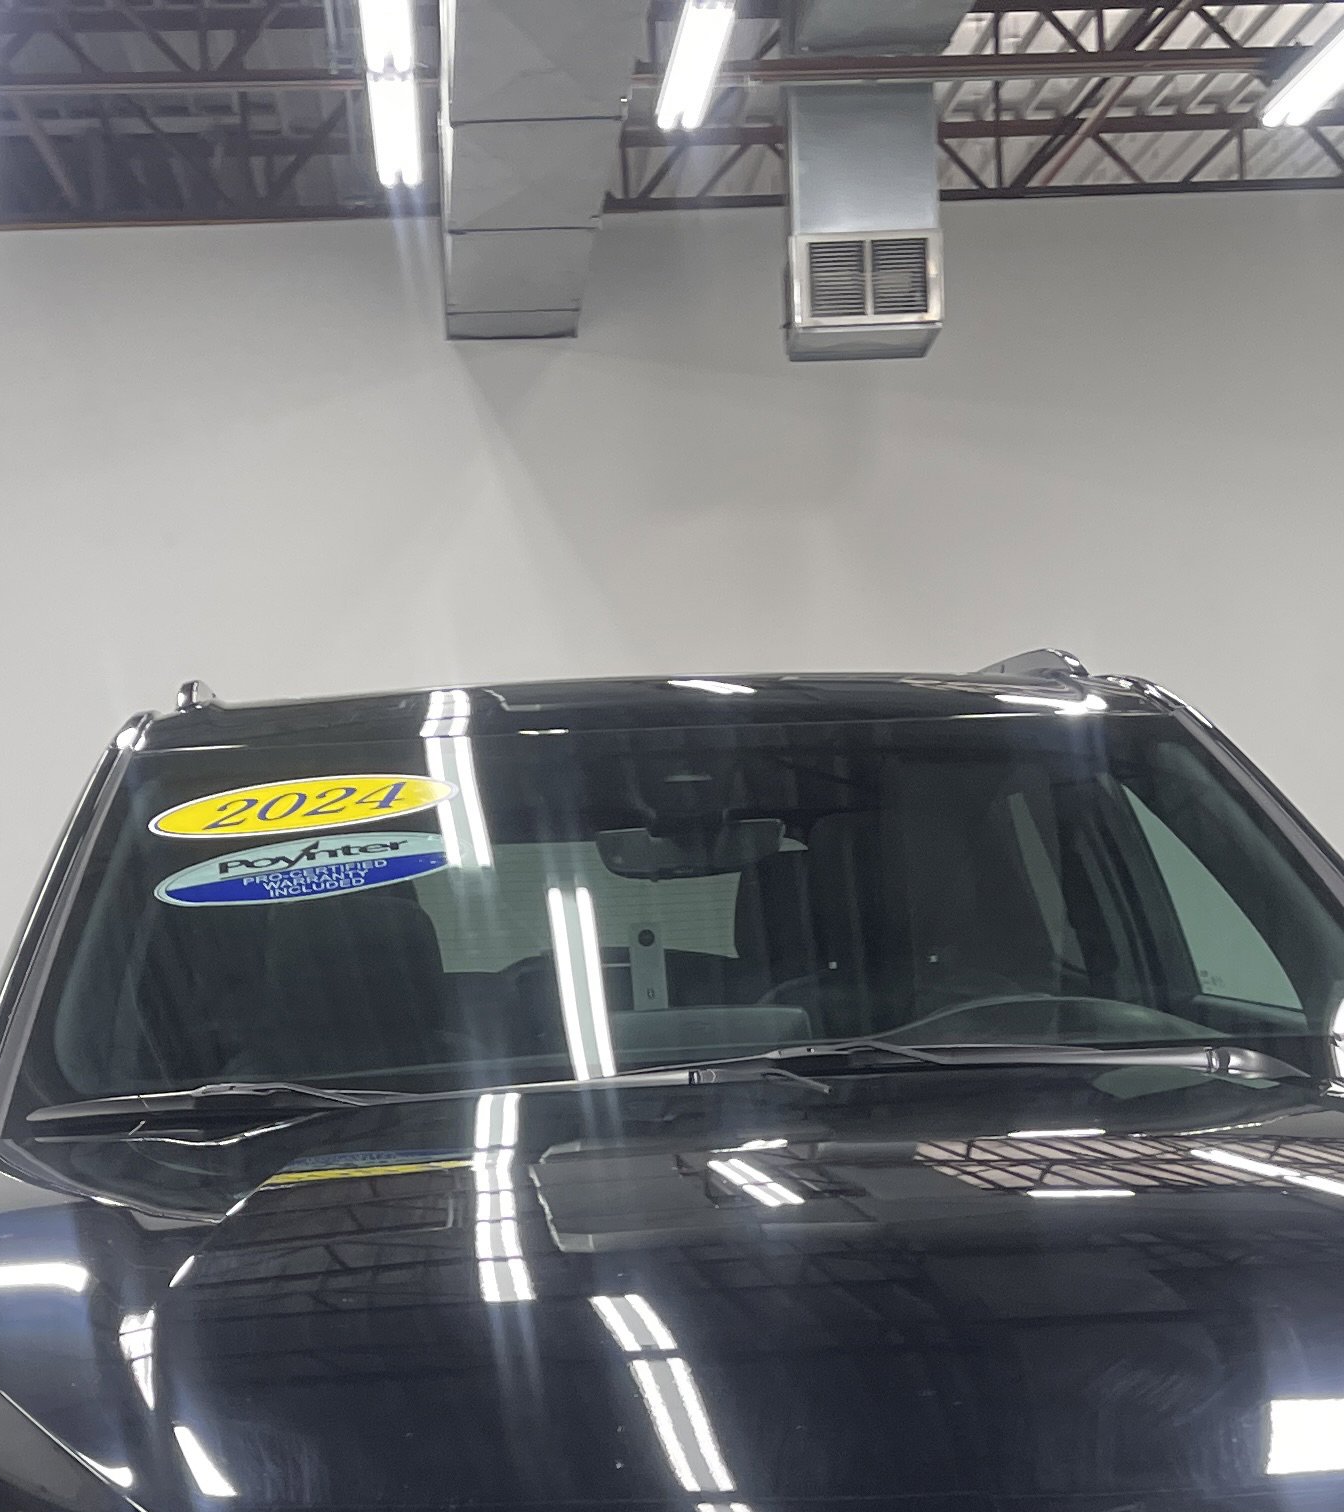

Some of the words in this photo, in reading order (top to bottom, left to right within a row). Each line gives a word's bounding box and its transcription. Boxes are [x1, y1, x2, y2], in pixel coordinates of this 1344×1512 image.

[202, 781, 407, 830] 2024
[219, 840, 408, 874] Poynter
[243, 859, 388, 886] PRO-CERTIFIED
[262, 869, 369, 890] WARRANTY
[269, 878, 365, 898] INCLUDED
